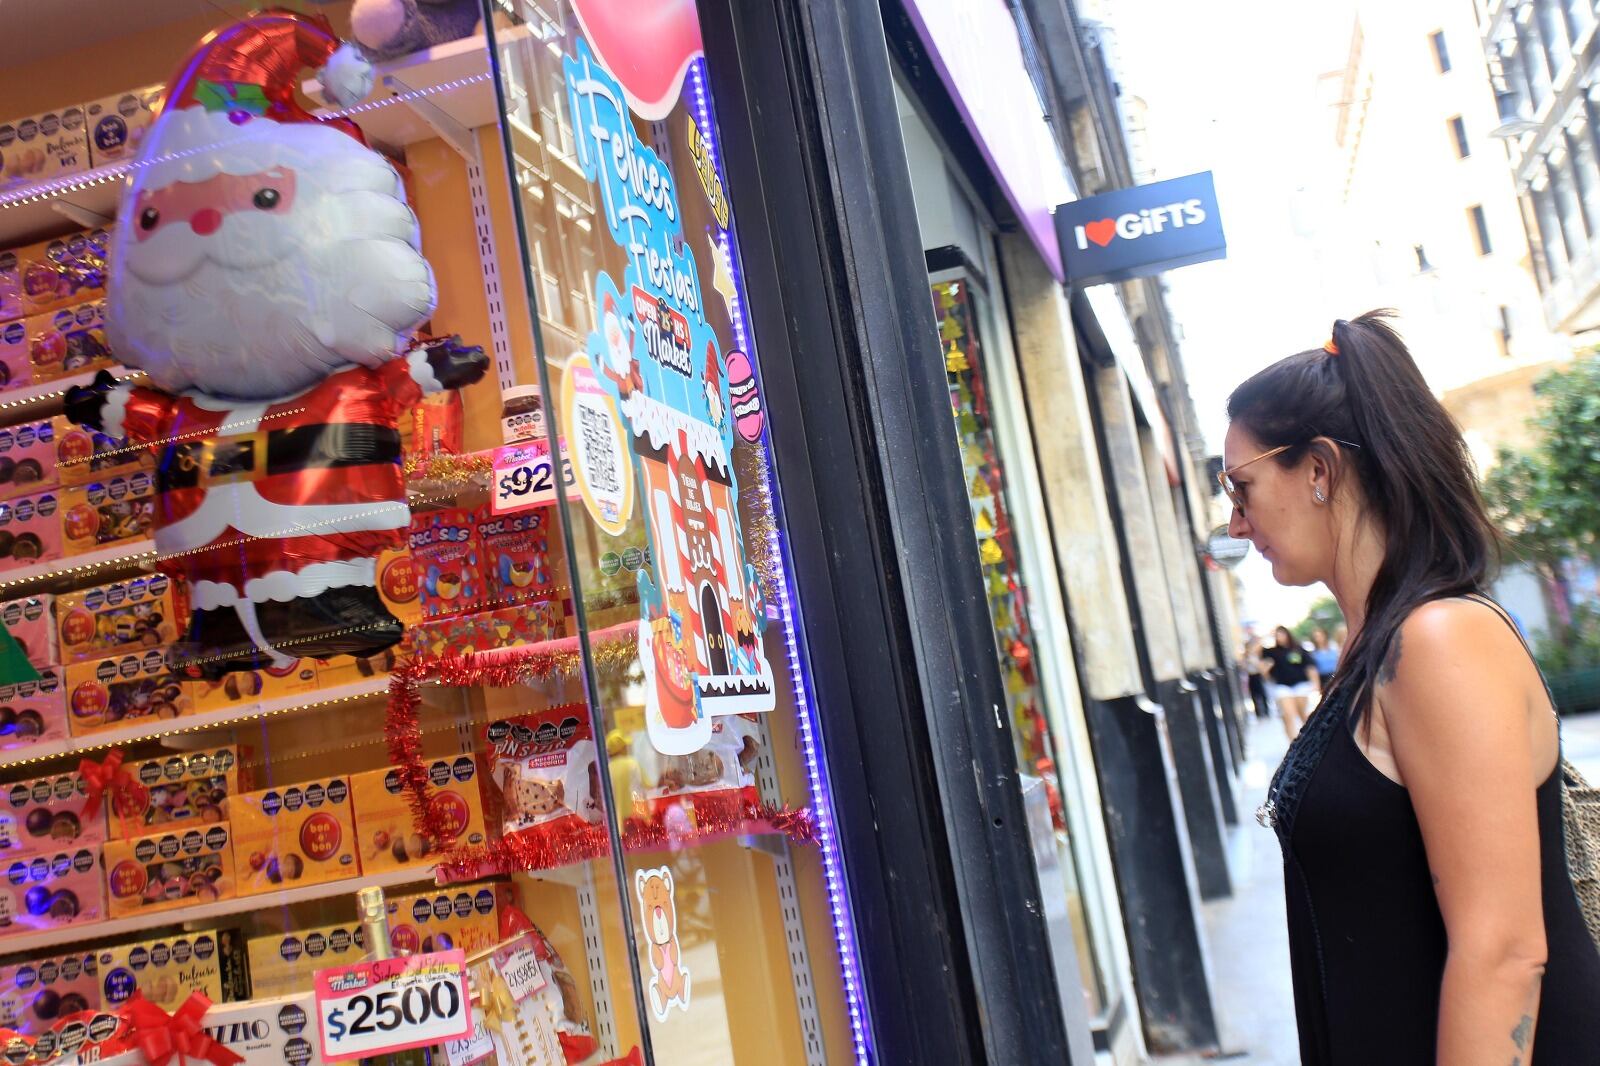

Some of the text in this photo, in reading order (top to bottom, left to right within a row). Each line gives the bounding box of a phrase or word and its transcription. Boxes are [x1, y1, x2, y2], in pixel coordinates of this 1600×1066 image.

[1074, 225, 1089, 250] I
[635, 295, 658, 322] OPEN
[643, 319, 692, 375] Market
[513, 423, 536, 433] nutella
[391, 567, 413, 577] bon
[393, 585, 415, 596] bon
[309, 823, 331, 833] bon
[311, 841, 332, 852] bon
[331, 977, 369, 993] Market
[327, 980, 460, 1042] $2500
